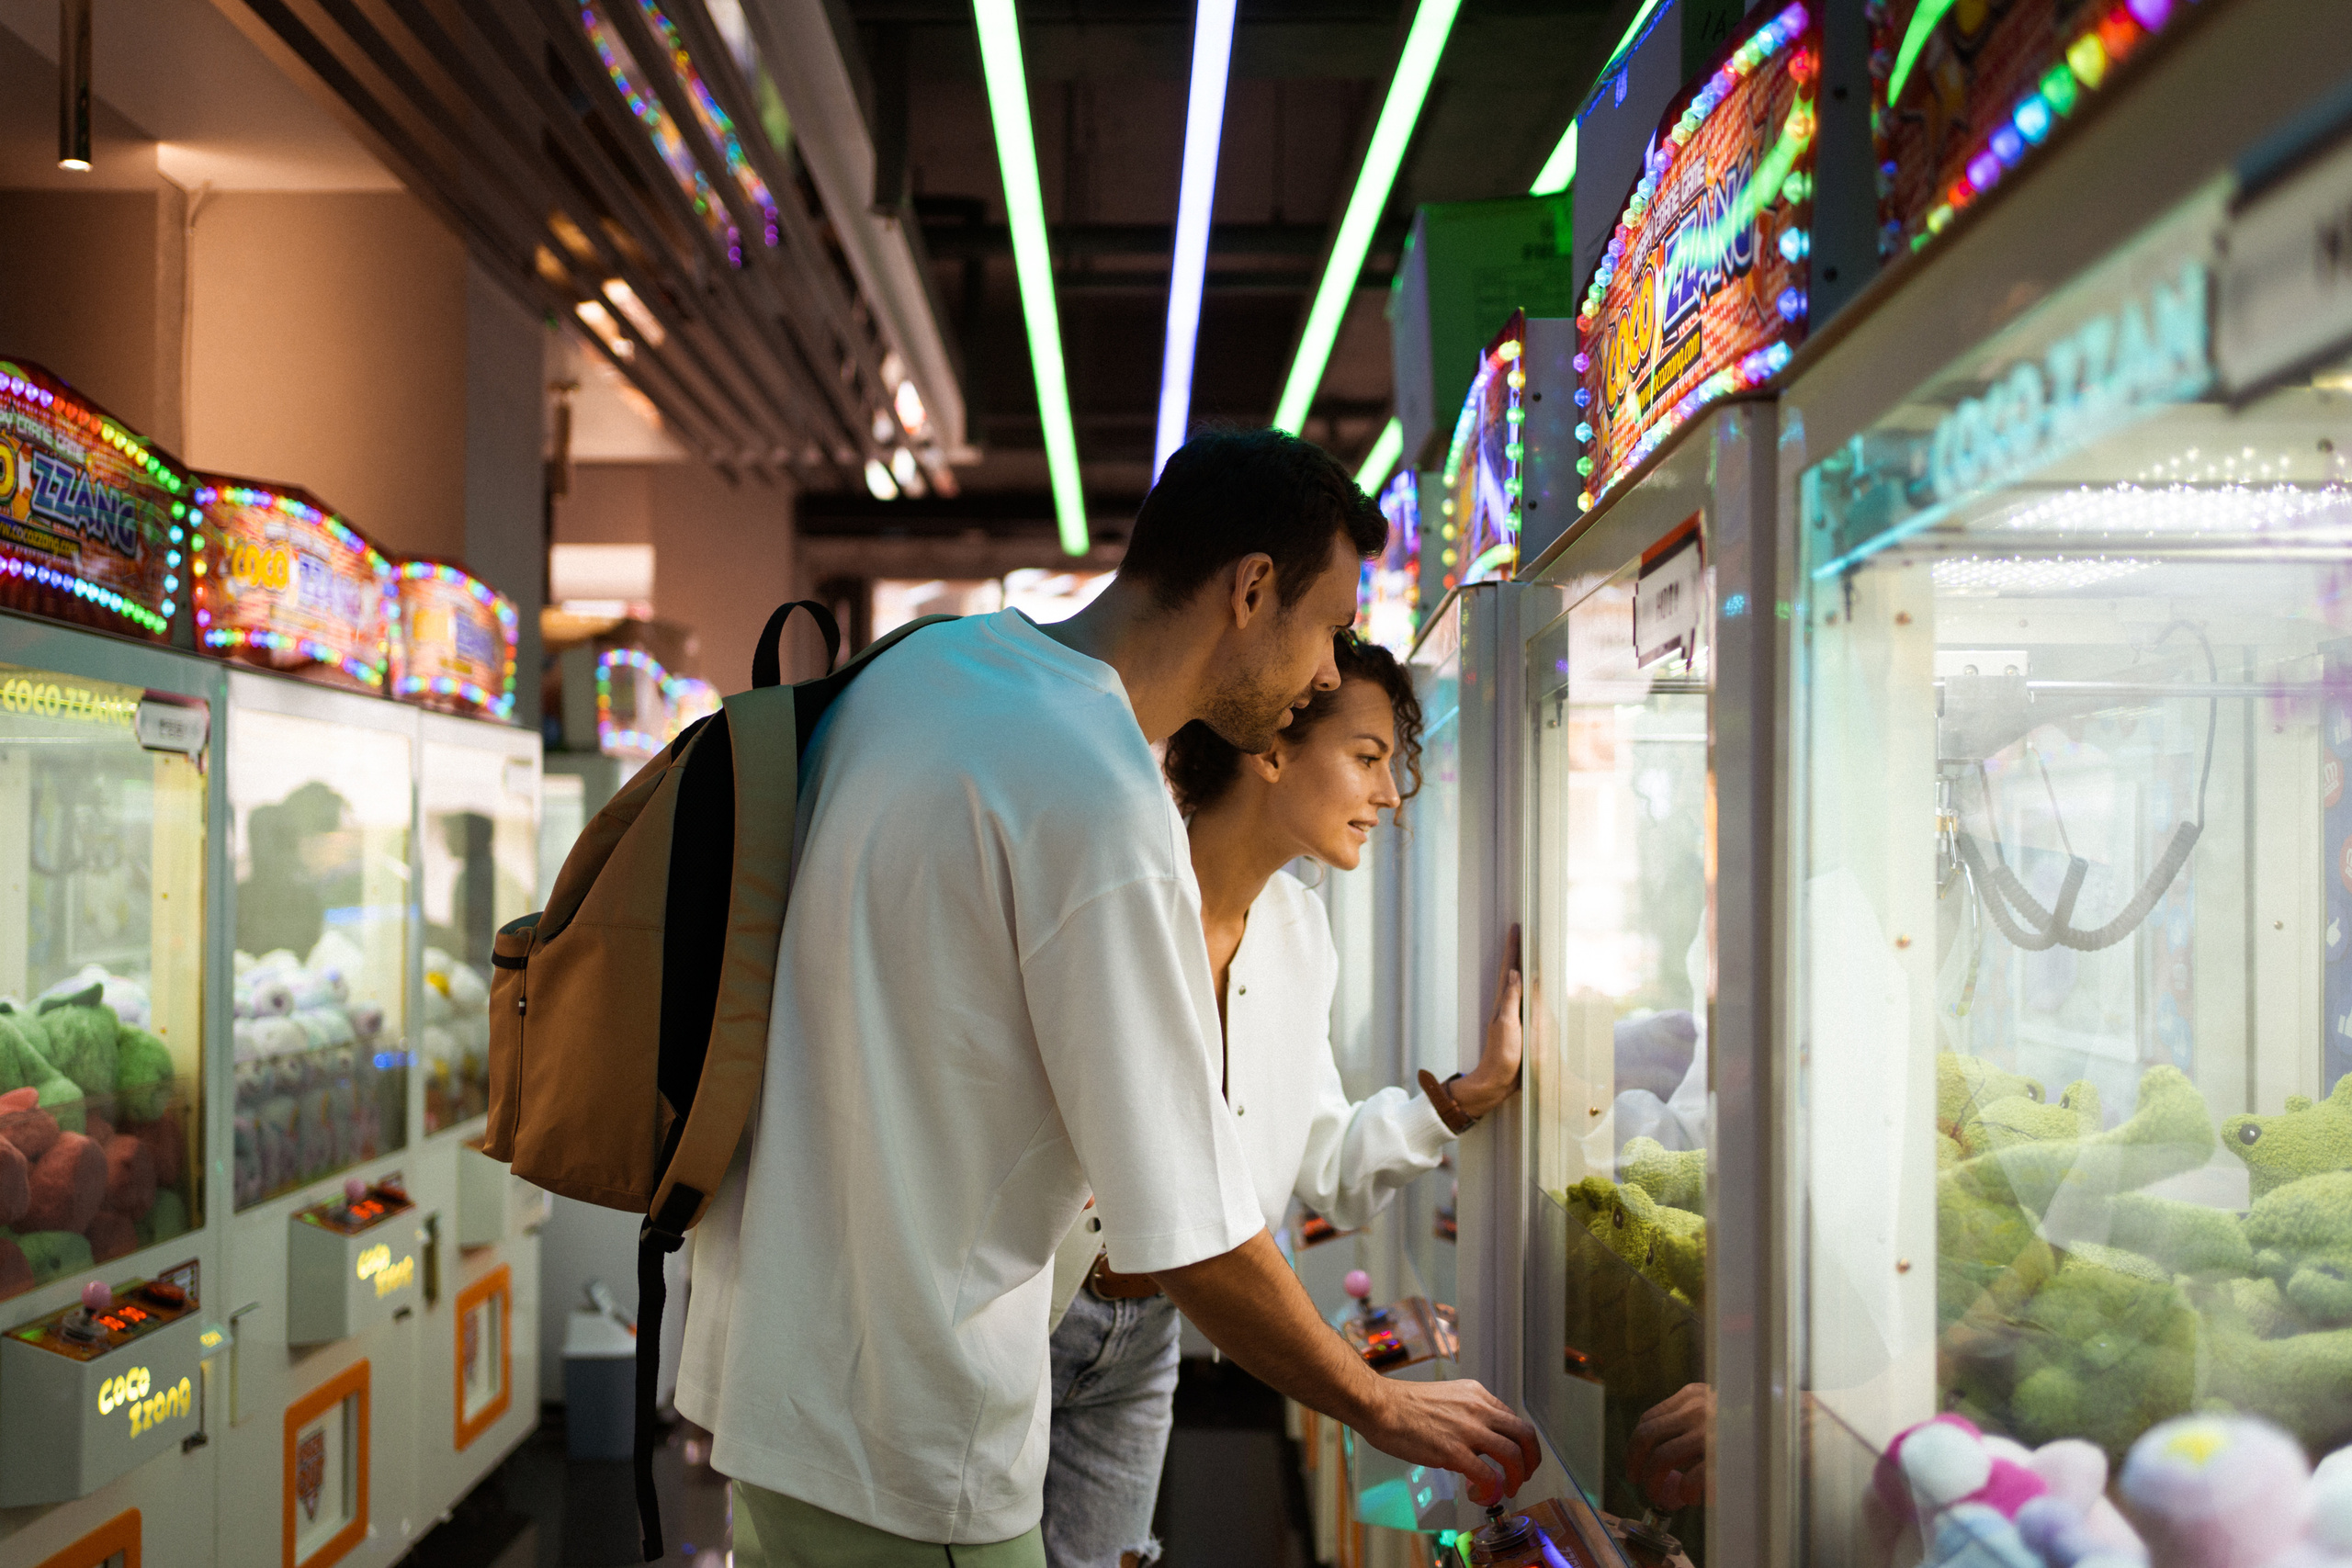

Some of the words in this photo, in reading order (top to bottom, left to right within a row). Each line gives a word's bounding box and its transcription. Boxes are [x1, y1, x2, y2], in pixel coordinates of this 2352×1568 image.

[1632, 218, 1654, 280] HAPPY
[1655, 181, 1679, 241] CRANE
[1680, 153, 1706, 204] GAME
[1607, 265, 1655, 413] COCO
[1662, 152, 1754, 333] ZZANG
[1638, 331, 1700, 410] wwwocozzang.com
[31, 449, 137, 558] ZZANG
[231, 540, 291, 592] COCO
[3, 678, 62, 716] COCO
